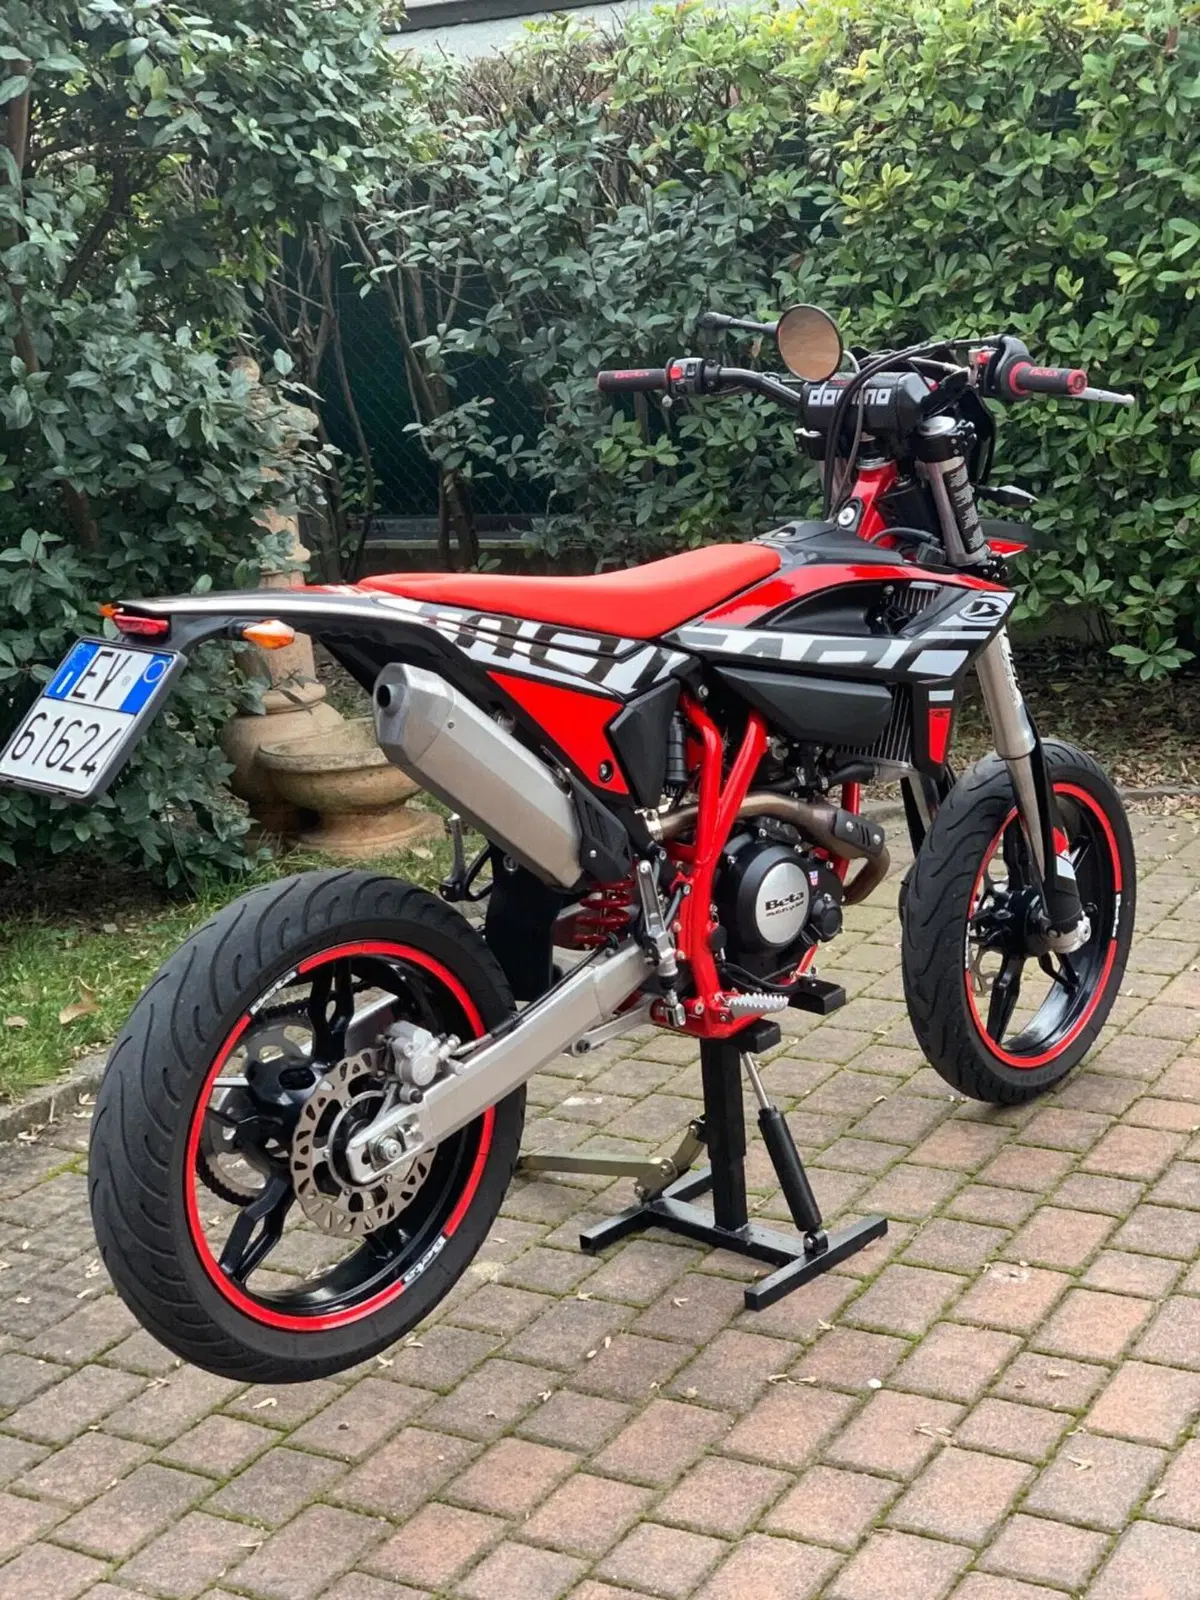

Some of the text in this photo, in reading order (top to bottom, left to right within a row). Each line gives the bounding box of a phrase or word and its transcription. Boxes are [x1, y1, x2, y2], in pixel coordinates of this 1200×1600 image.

[808, 381, 892, 406] dono
[71, 650, 131, 702] EV
[11, 711, 122, 777] 61624
[765, 891, 804, 910] Beta
